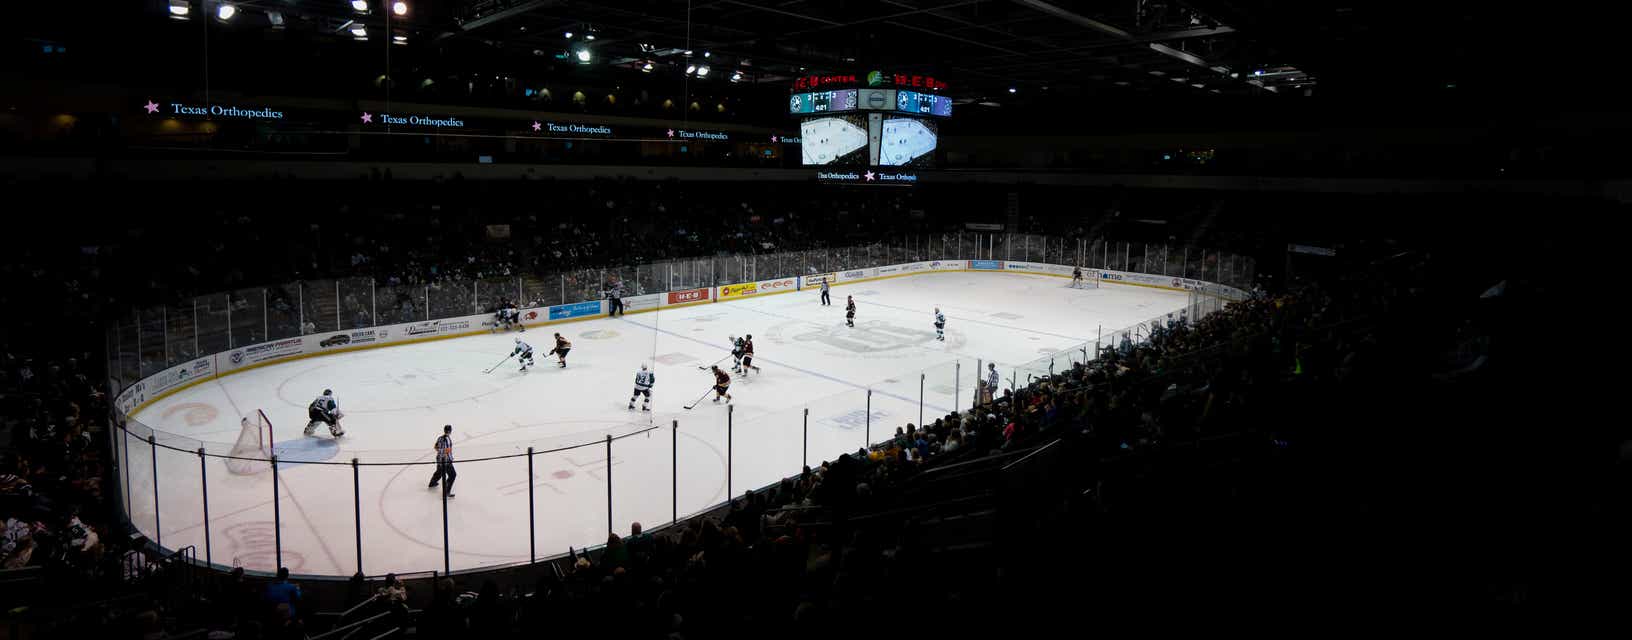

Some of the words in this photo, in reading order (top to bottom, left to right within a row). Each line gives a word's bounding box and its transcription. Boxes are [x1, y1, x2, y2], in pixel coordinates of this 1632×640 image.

[171, 103, 208, 115] Texas
[211, 105, 283, 119] Orthopedics
[380, 114, 407, 125] Texas
[409, 115, 464, 128] Orthopedics
[547, 123, 568, 133] Texas
[569, 124, 611, 135] Orthopedics
[679, 130, 695, 138] Texas
[695, 131, 728, 141] Orthopedics
[828, 172, 859, 181] Orthopedics
